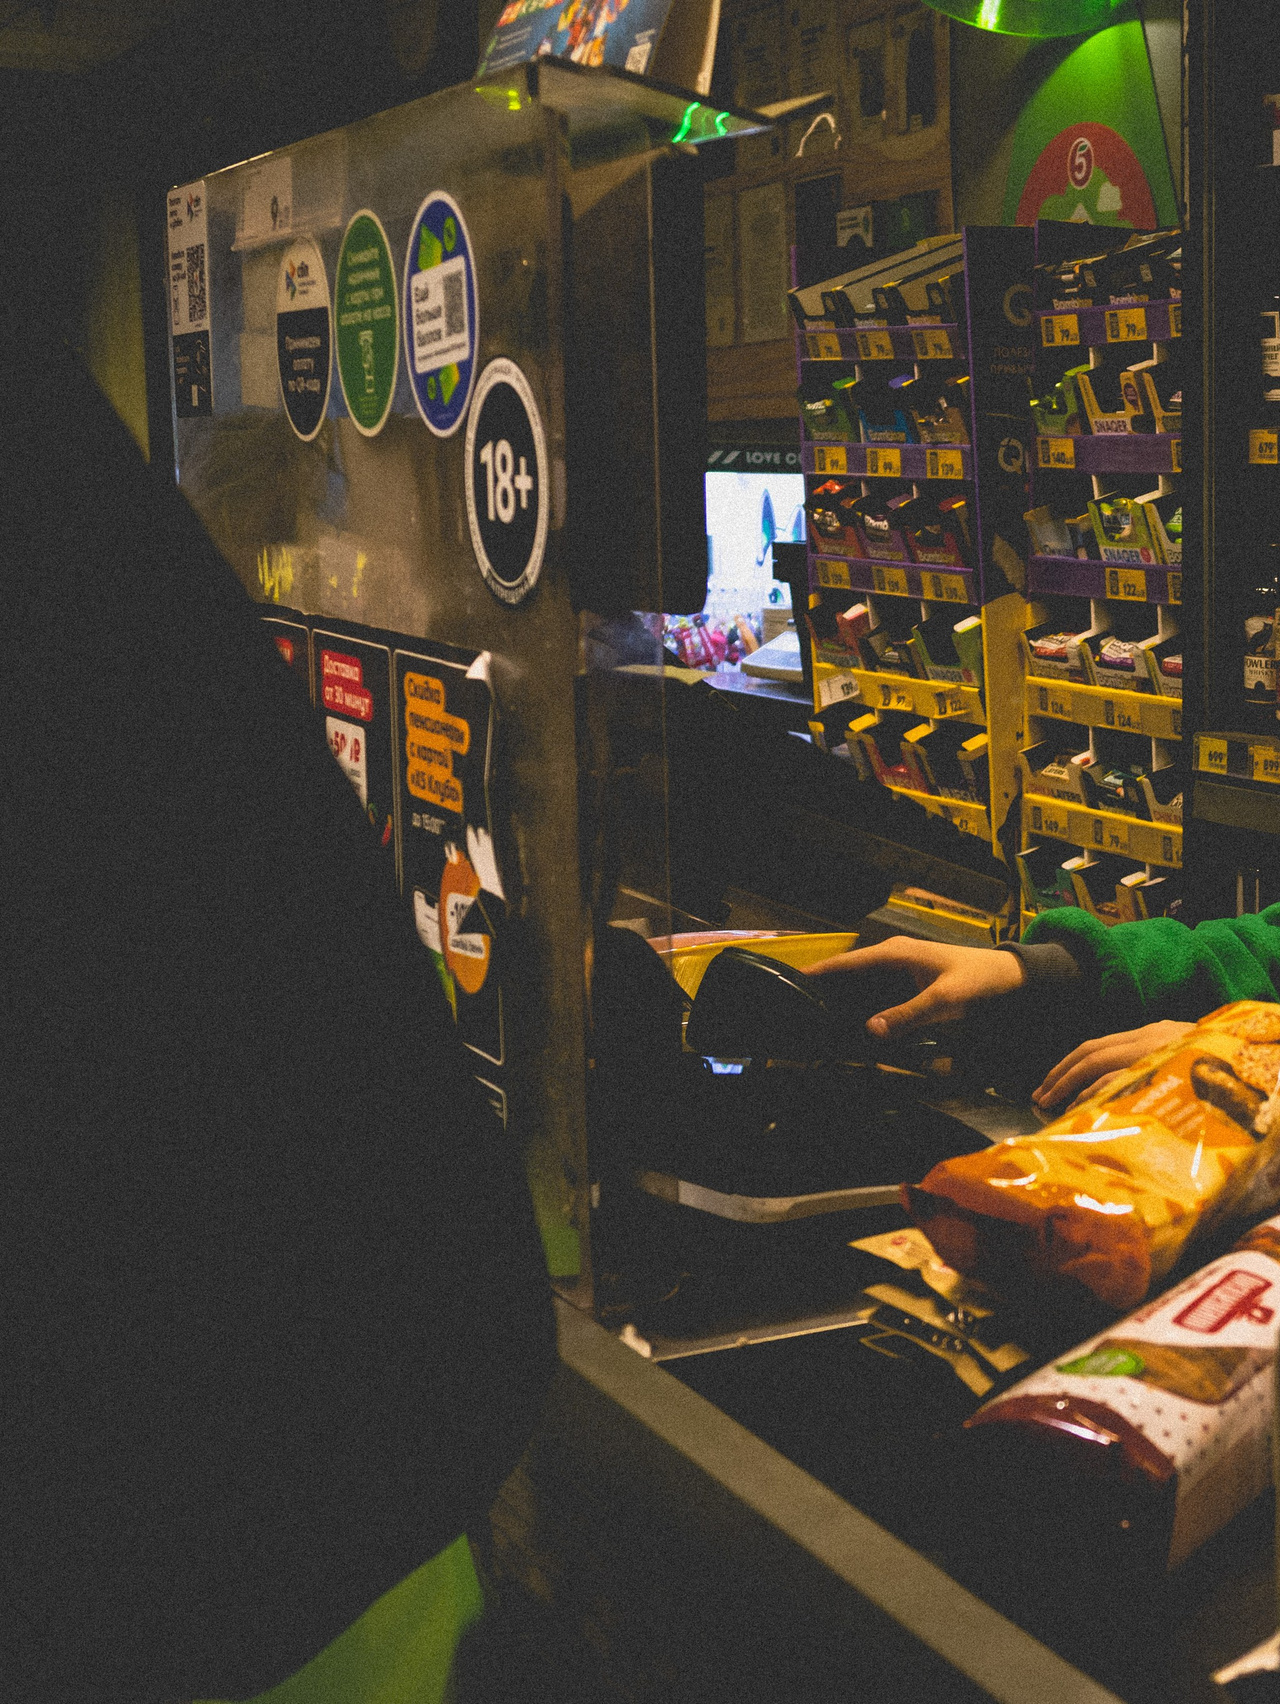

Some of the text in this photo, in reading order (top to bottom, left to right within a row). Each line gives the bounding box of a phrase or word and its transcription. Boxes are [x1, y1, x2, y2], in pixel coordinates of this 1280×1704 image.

[1074, 143, 1087, 182] 5
[746, 451, 781, 464] LOVE
[480, 438, 534, 525] 18+
